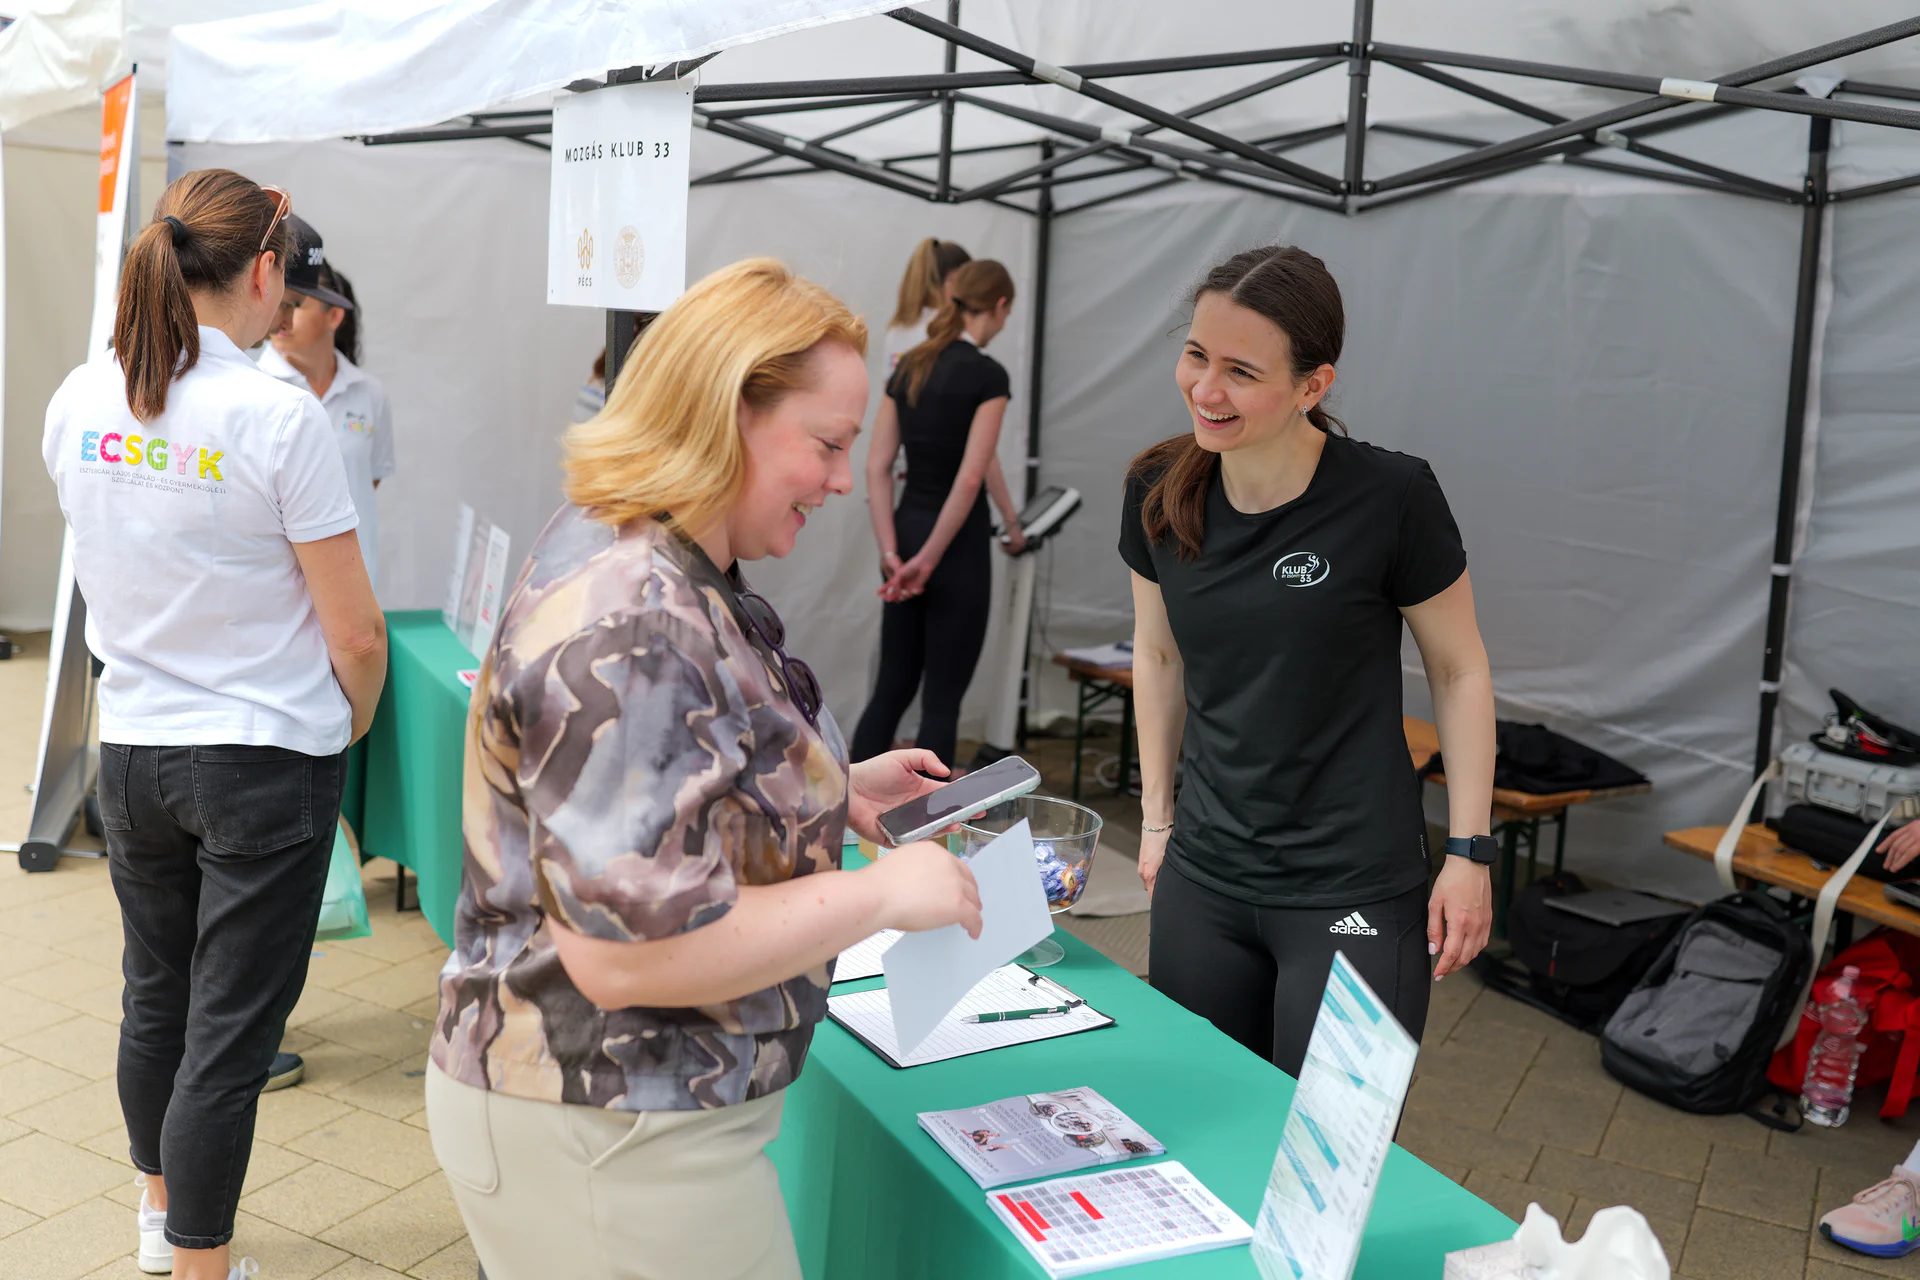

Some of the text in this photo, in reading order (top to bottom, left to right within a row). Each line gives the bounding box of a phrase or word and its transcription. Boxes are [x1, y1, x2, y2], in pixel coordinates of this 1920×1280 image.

[565, 140, 670, 163] MOZGÁS KLUB 33
[577, 273, 593, 287] PÉCS
[81, 430, 225, 481] ECSGYK
[112, 469, 131, 477] LAJOS
[1281, 566, 1307, 575] KLUB
[1299, 574, 1312, 583] 33
[1329, 925, 1378, 936] adidas
